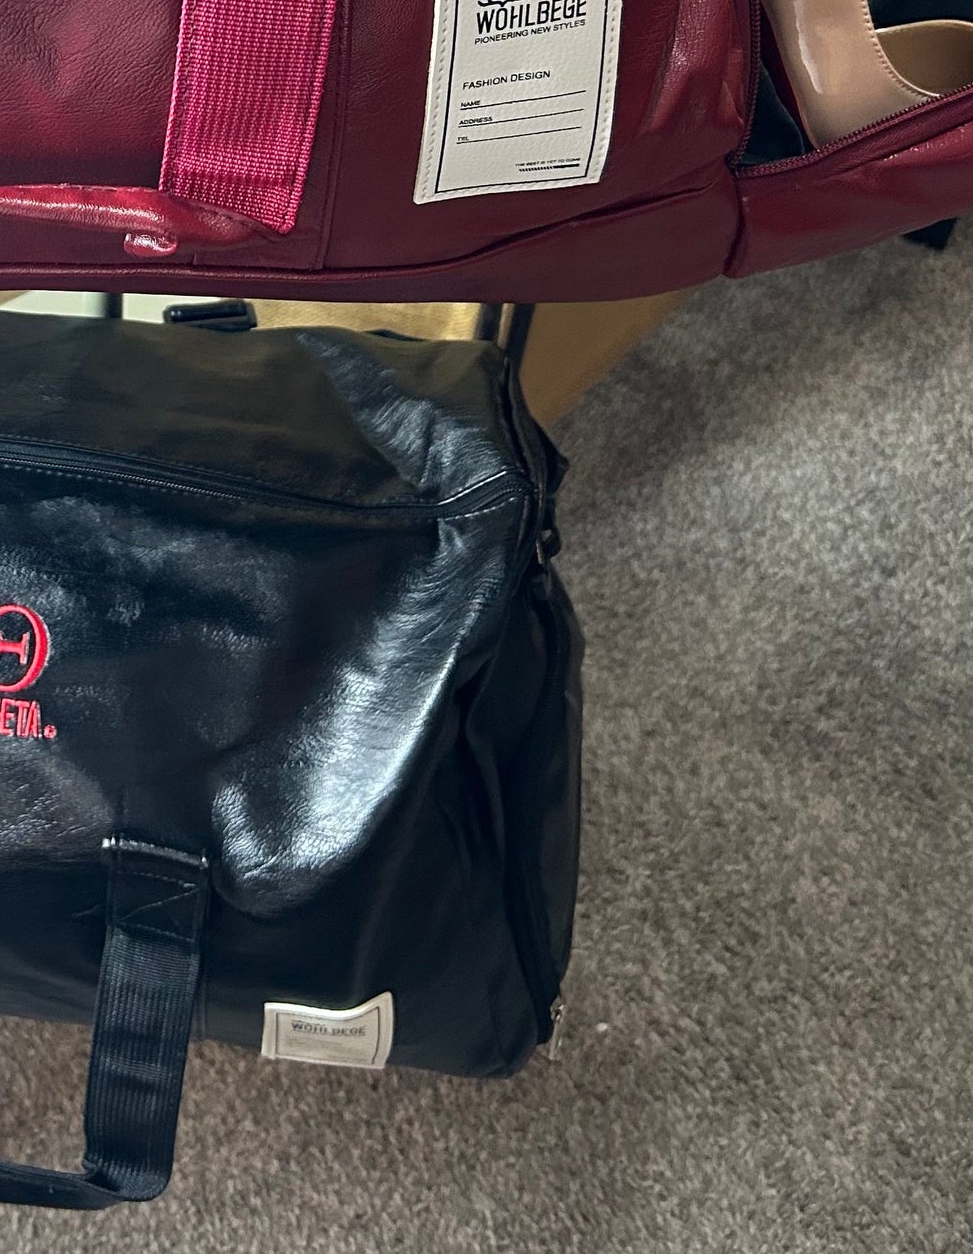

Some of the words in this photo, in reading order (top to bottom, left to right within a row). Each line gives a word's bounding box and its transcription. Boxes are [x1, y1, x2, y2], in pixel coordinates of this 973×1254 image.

[474, 29, 529, 45] PIONEERING
[530, 25, 552, 35] NEW
[553, 19, 586, 32] STYLES
[462, 75, 508, 90] FASHION
[510, 70, 551, 83] DESIGN
[460, 99, 481, 108] NAME
[458, 116, 493, 126] ADDRESS
